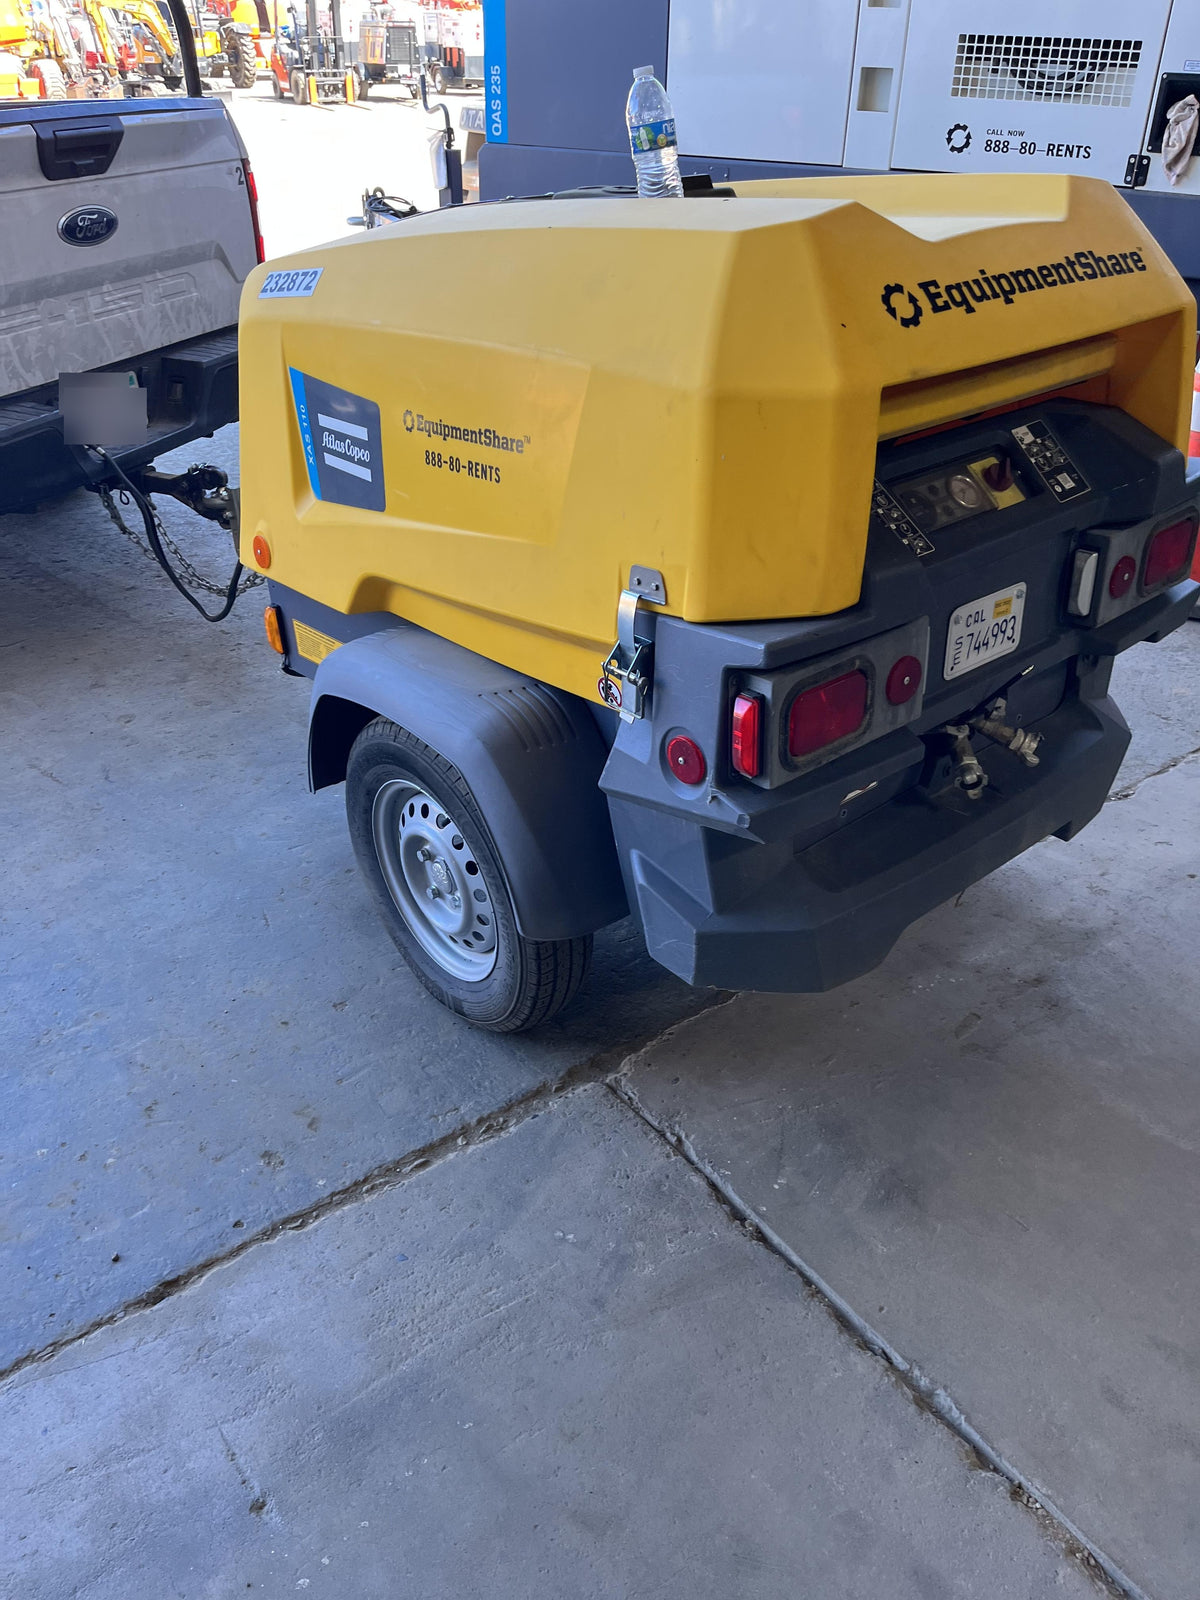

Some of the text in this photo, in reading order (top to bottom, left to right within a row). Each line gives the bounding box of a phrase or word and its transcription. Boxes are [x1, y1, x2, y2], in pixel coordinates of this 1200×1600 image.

[490, 65, 503, 136] QAS 235
[984, 139, 1092, 159] 888-80-RENTS
[986, 128, 1004, 136] CALL
[76, 213, 108, 239] Ford
[260, 270, 319, 294] 232872
[917, 249, 1147, 315] EquipmentShare
[300, 404, 315, 466] XAS 110
[416, 413, 525, 454] EquipmentShare
[424, 449, 501, 484] 888-80-RENTS
[965, 608, 987, 628] CAL
[965, 615, 1017, 660] 744993
